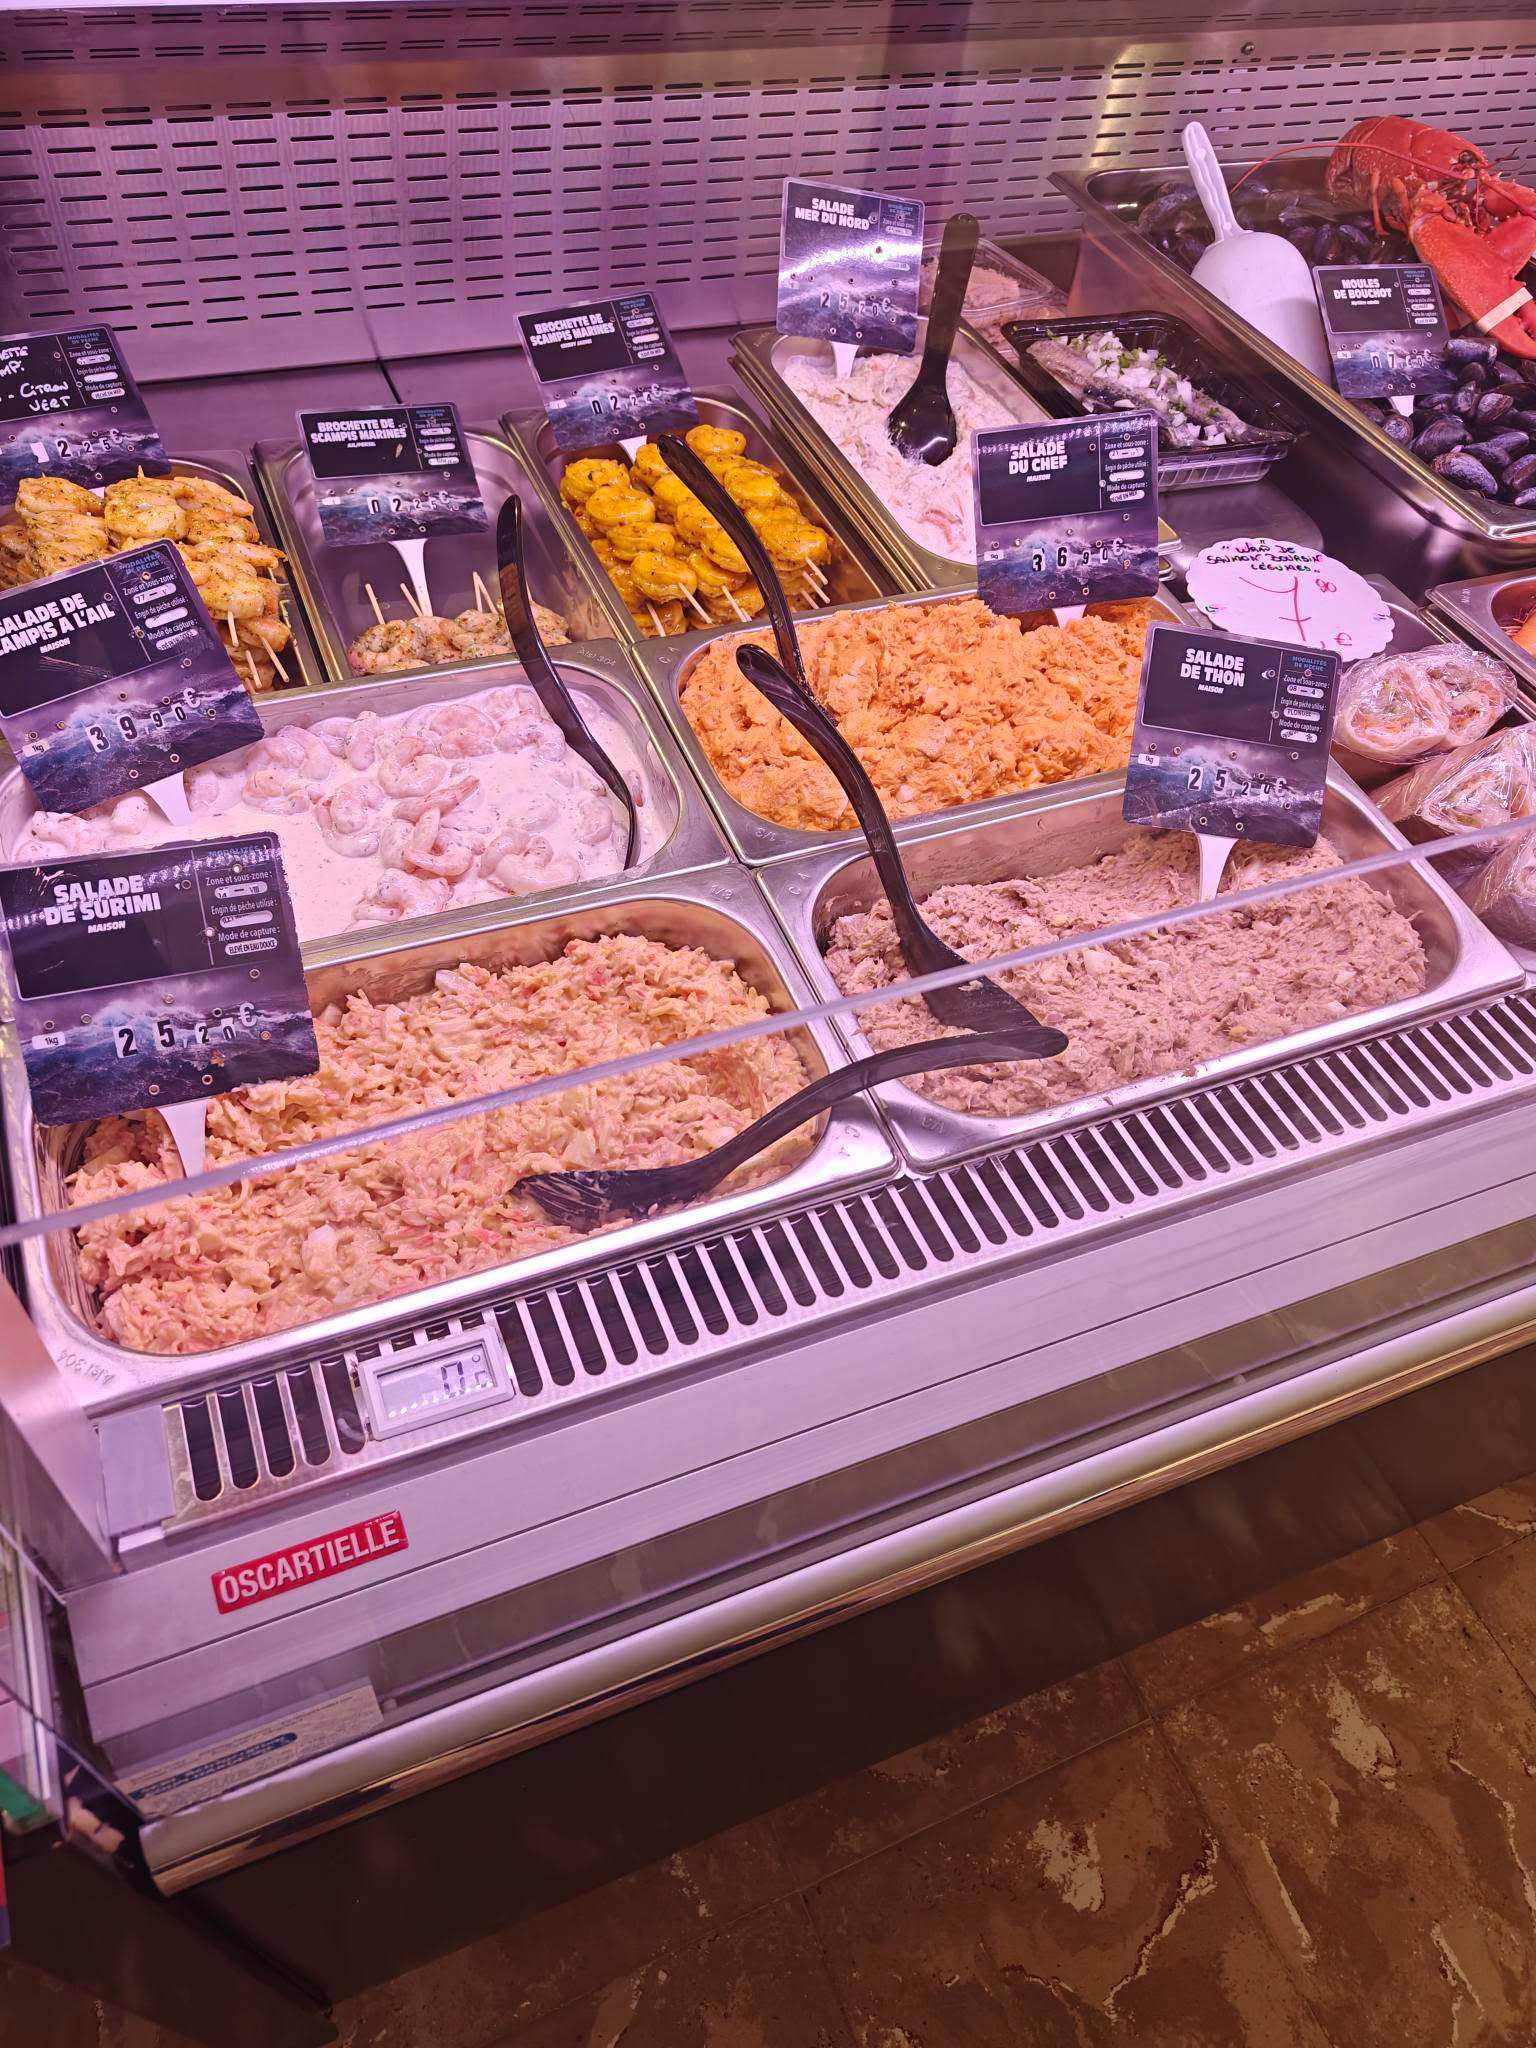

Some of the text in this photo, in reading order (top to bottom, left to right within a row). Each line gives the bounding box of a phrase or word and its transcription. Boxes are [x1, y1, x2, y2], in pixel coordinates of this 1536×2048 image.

[812, 198, 854, 216] SALADE
[795, 207, 819, 222] MER
[821, 211, 837, 225] DU
[839, 215, 869, 231] NORD
[1342, 278, 1380, 289] MOULES
[1333, 288, 1392, 299] DE BOUCHOT
[534, 315, 588, 334] BROCHETTE
[589, 313, 603, 325] DE
[530, 331, 573, 346] SCAMPIS
[574, 322, 615, 338] MARINES
[29, 396, 71, 411] VERT
[317, 418, 395, 433] BROCHETTE DE
[311, 430, 357, 444] SCAMPIS
[359, 428, 407, 441] MARINES
[1010, 441, 1065, 460] SALADE
[1009, 455, 1068, 475] DU CHEF
[1026, 474, 1051, 482] MAISON
[1275, 545, 1295, 553] DE
[123, 585, 139, 596] Zone
[60, 593, 87, 614] DE
[0, 603, 115, 657] AMPIS A L'AIL
[147, 631, 164, 641] Mode
[40, 637, 71, 654] MAISON
[1186, 648, 1244, 671] SALADE
[1180, 663, 1245, 687] DE THON
[1284, 675, 1297, 683] Zone
[1198, 684, 1224, 694] MAISON
[1279, 719, 1293, 727] Mode
[32, 743, 44, 753] 1kg
[205, 876, 224, 886] Zone
[225, 875, 232, 883] et
[54, 875, 145, 904] SALADE
[44, 892, 161, 926] DE SURIMI
[211, 906, 229, 916] Engin
[229, 903, 236, 911] de
[237, 901, 255, 912] pêche
[87, 920, 126, 934] MAISON
[218, 931, 239, 942] Mode
[240, 929, 249, 938] de
[250, 941, 260, 950] EAU
[260, 939, 275, 949] DOUCE
[45, 1036, 59, 1046] 1kg
[219, 1519, 400, 1604] OSCARTIELLE
